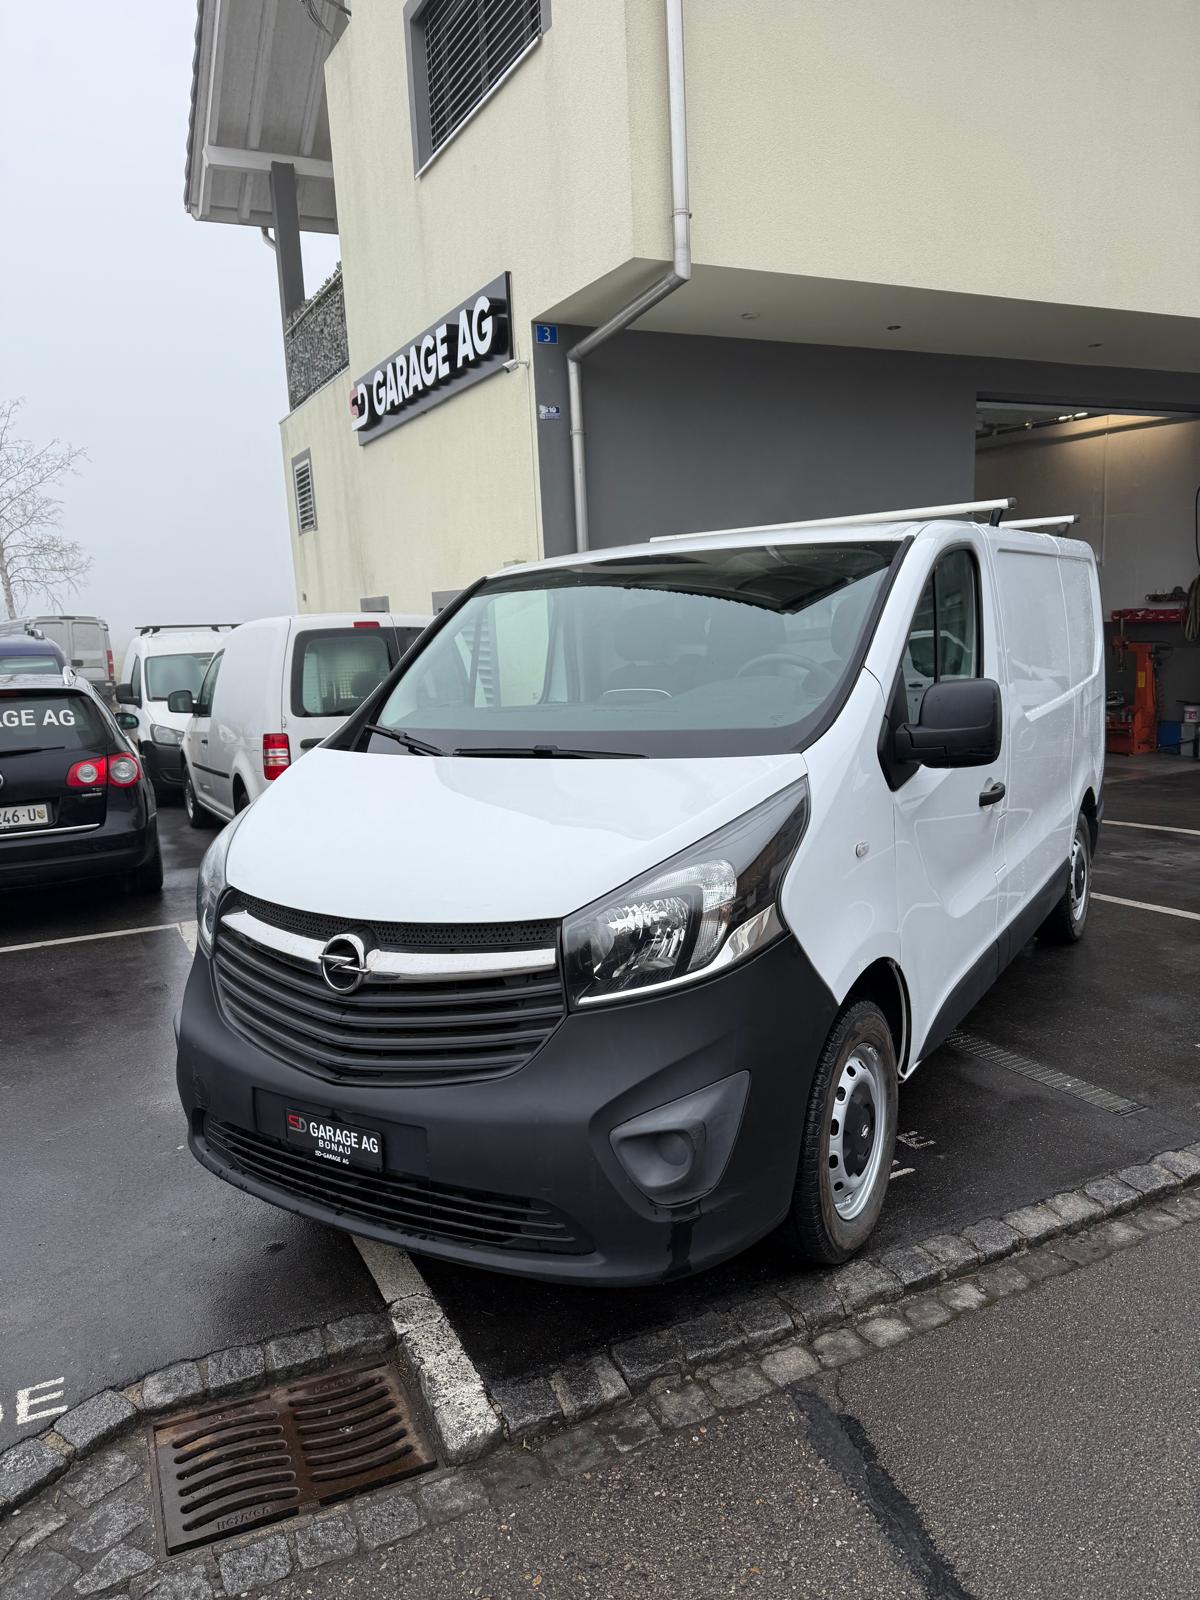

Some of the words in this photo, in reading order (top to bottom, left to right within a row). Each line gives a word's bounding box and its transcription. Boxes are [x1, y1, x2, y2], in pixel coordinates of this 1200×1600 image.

[543, 326, 551, 342] 3
[372, 323, 450, 416] GARAGE
[457, 295, 493, 368] AG
[0, 709, 36, 727] GE
[42, 709, 76, 726] AG
[309, 1121, 359, 1149] GARAGE
[361, 1135, 379, 1153] AG
[318, 1139, 351, 1155] BONAU
[0, 1376, 69, 1425] E
